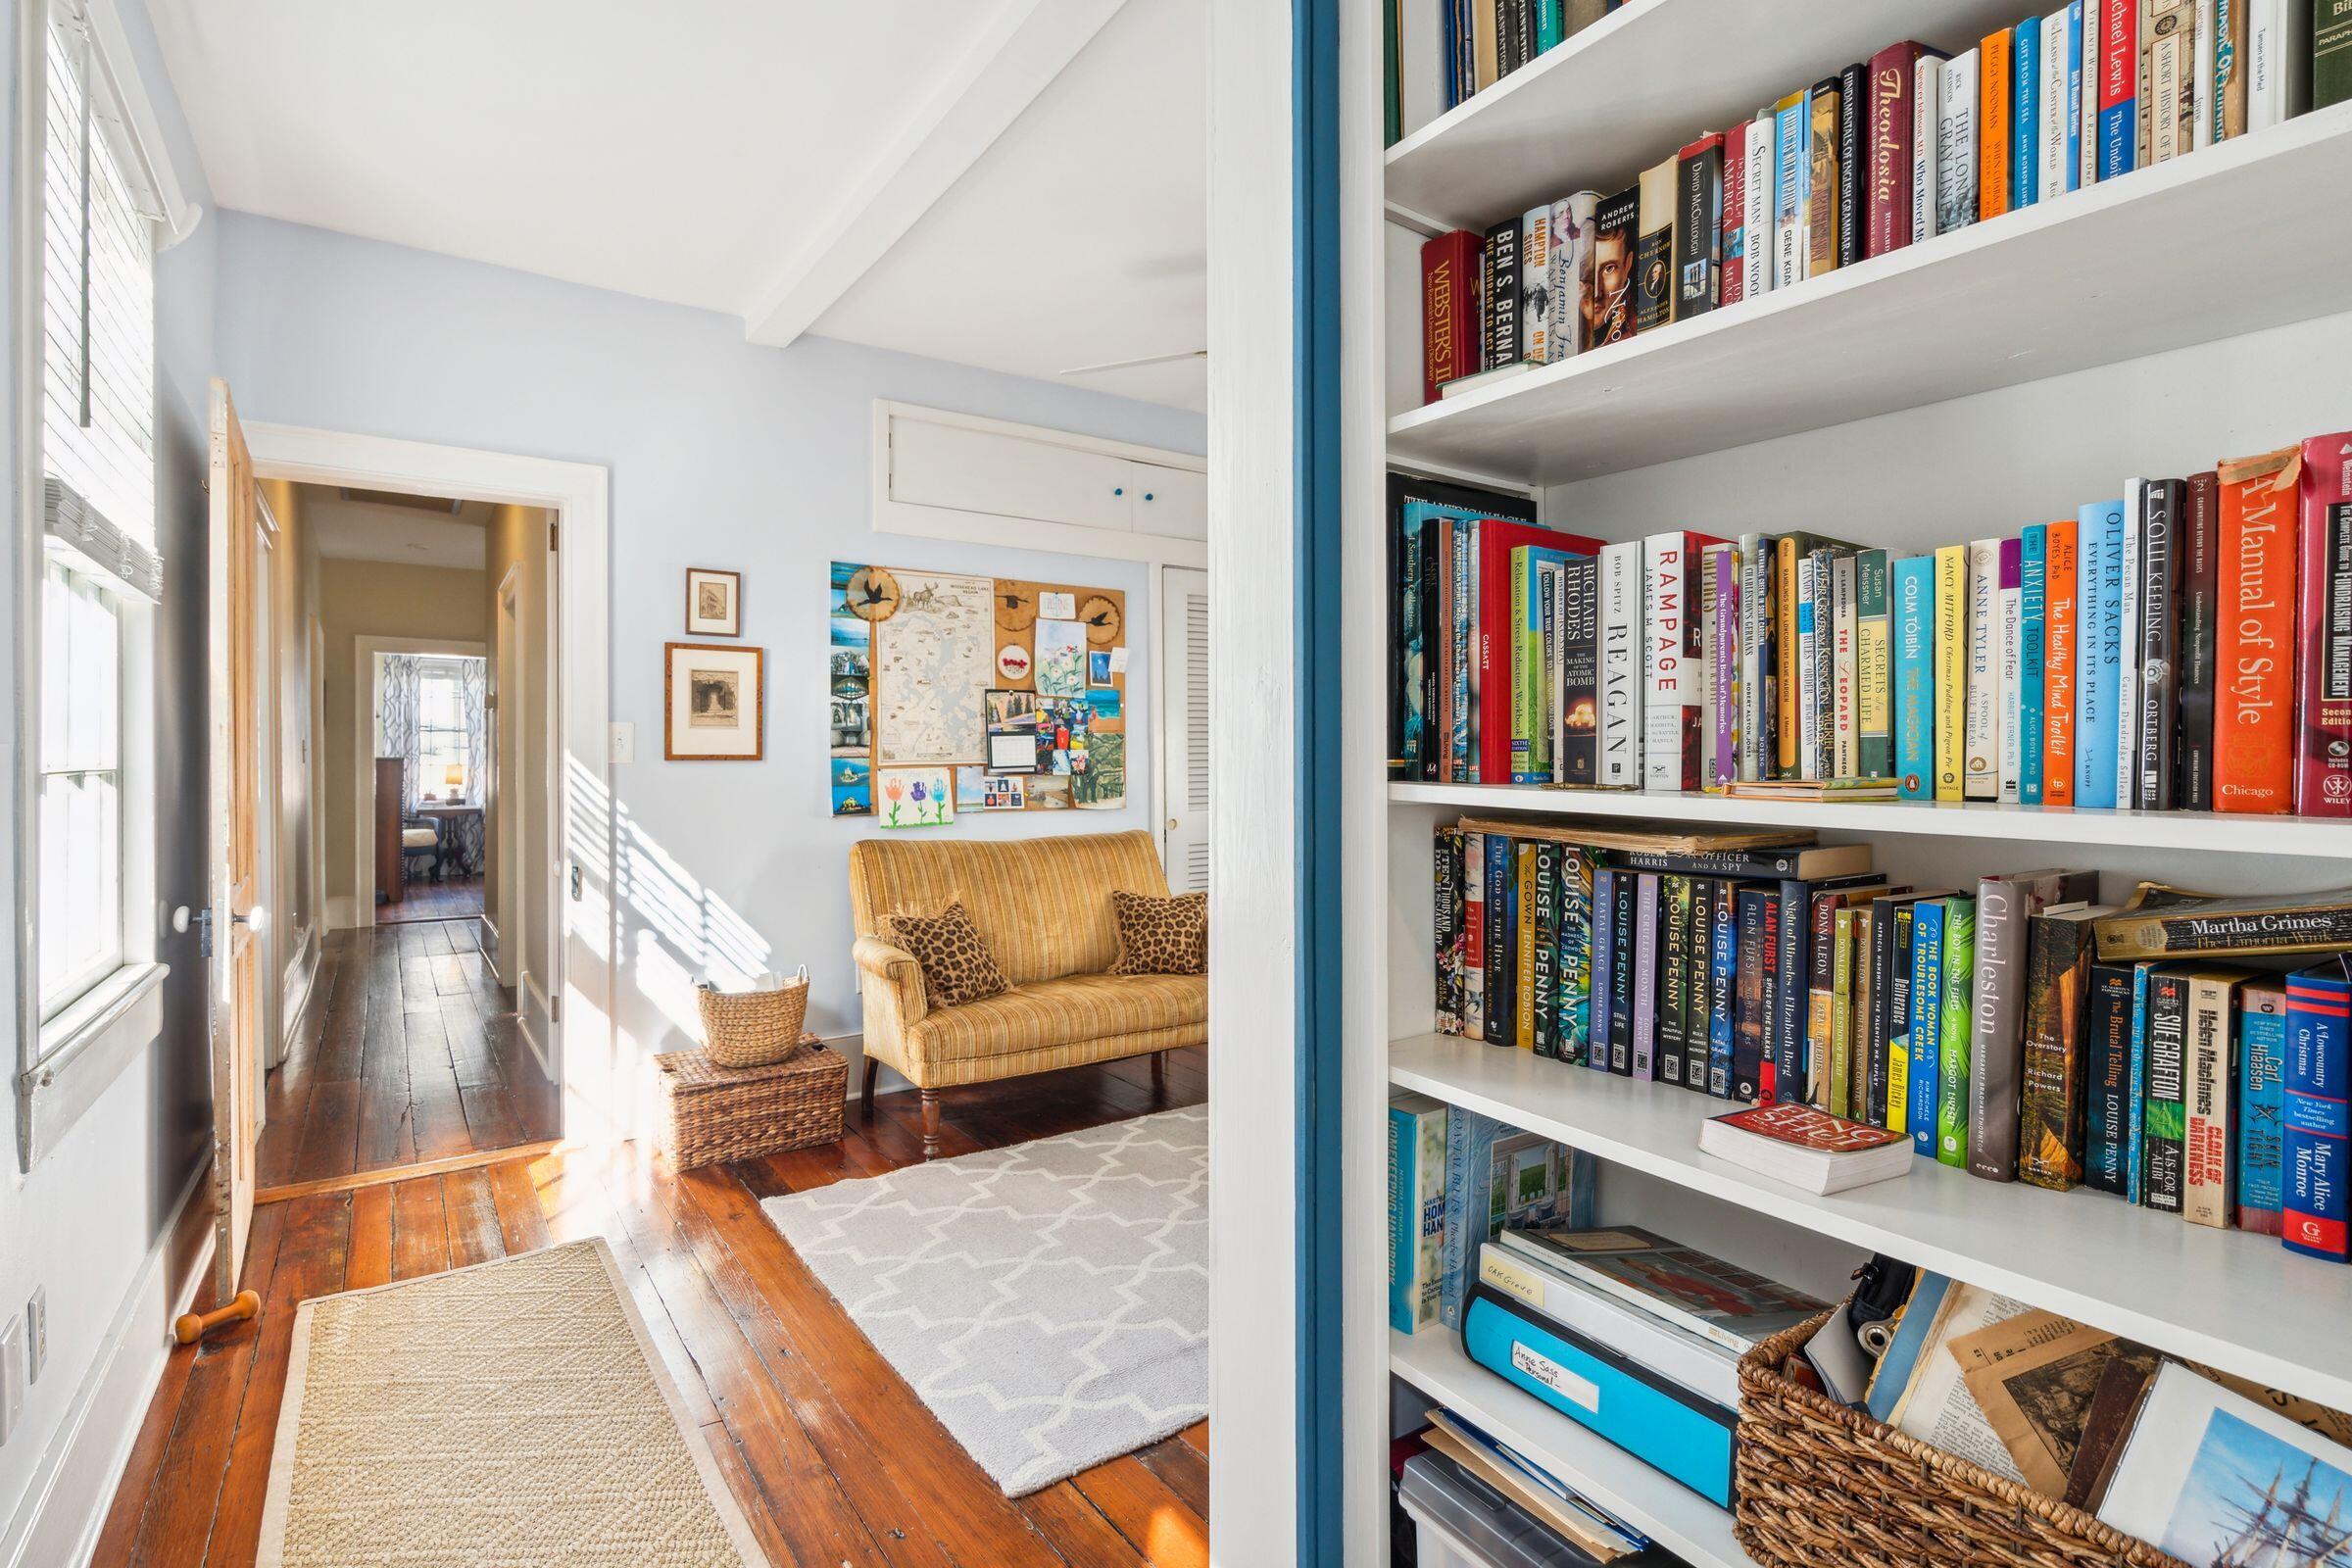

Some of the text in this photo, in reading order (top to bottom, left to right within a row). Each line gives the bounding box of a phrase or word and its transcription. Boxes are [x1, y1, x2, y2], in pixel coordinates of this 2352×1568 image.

[2020, 38, 2029, 60] GIFT
[2109, 45, 2128, 97] Lewis
[1989, 80, 1999, 130] NOONAN
[2070, 69, 2081, 138] Jack Russell Terriers
[2110, 110, 2124, 131] The
[2160, 88, 2172, 131] HISTORY
[1840, 71, 1854, 252] FUNDAMENTALS OF ENGLISH GRAMMAR
[1878, 68, 1901, 203] Theodosia
[1939, 117, 1954, 214] GRAY LINE
[1992, 139, 2002, 165] WHEN
[1691, 161, 1703, 192] DAVID
[1723, 159, 1735, 227] AMERICA
[1750, 145, 1766, 257] SECRET MAN BOB
[1600, 212, 1635, 231] ROBERTS
[1601, 202, 1636, 221] ANDREW
[1497, 229, 1514, 270] BEN
[1523, 233, 1533, 266] SIDES
[1533, 218, 1546, 268] HAMPTON
[1435, 260, 1452, 363] WEBSTER'S
[1485, 261, 1494, 311] COURAGE
[1558, 241, 1575, 324] Benjamin
[1638, 308, 1670, 324] HAMILTON
[1861, 563, 1872, 607] Meissner
[1873, 568, 1885, 599] Susan
[2063, 544, 2073, 571] ALICE
[1567, 565, 1583, 641] RHODES
[1582, 563, 1595, 640] RICHARD
[1904, 575, 1919, 614] COLM
[1944, 556, 1955, 641] NANCY MITFORD
[2023, 559, 2044, 679] ANXIETY TOOLKIT
[2103, 512, 2122, 666] OLIVER SACKS
[2230, 501, 2277, 725] Manual Style
[1645, 565, 1654, 680] JAMES SCOTT
[1658, 550, 1679, 692] RAMPAGE
[1838, 628, 1849, 655] THE
[1974, 574, 1988, 675] ANNE TYLER
[2004, 598, 2017, 680] The Dance Fear
[2084, 542, 2098, 725] EVERYTHING IN ITS PLACE
[1482, 634, 1491, 671] CASSATT
[1566, 676, 1595, 687] BOMB
[1860, 628, 1874, 724] CHARMED LIFE
[2046, 597, 2071, 757] The Healthy Mind Toolkit
[2331, 636, 2351, 697] MANAGEMENT
[1514, 691, 1525, 737] Workbook
[1606, 623, 1629, 755] REAGAN
[1968, 684, 1978, 748] BLUE THREAD
[2145, 699, 2159, 762] ORTBERG
[2222, 783, 2275, 798] Chicago
[1536, 843, 1551, 919] LOUISE
[1564, 846, 1581, 923] LOUISE
[1631, 857, 1668, 867] HARRIS
[1523, 879, 1533, 983] GOWN JENNIFER
[1616, 890, 1628, 1004] LOUISE PENNY
[1668, 894, 1681, 1011] LOUISE PENNY
[1744, 903, 1758, 977] ALAN FURST
[1764, 901, 1779, 973] ALAN FURST
[1816, 904, 1830, 976] DONNA LEON
[2190, 914, 2332, 936] Martha Grimes
[1535, 949, 1550, 1020] PENNY
[1693, 896, 1707, 1015] LOUISE PENNY
[1715, 901, 1729, 1022] LOUISE PENNY
[1978, 893, 2009, 1036] Charleston
[1558, 955, 1579, 1027] PENNY
[1613, 1012, 1627, 1021] STILL
[1892, 977, 1911, 1024] Deliverance
[1914, 922, 1928, 1061] OF TROUBLESOME CREEK
[1926, 940, 1938, 1047] THE BOOK WOMAN
[2025, 1040, 2068, 1054] Overstory
[2038, 1033, 2055, 1042] The
[2152, 1013, 2181, 1040] SUE
[2297, 1028, 2311, 1077] Christmas
[2027, 1066, 2063, 1081] Richard
[2028, 1080, 2062, 1093] Powers
[2151, 1041, 2180, 1101] GRAFTON
[2249, 1043, 2270, 1092] Hiaasen
[2264, 1055, 2283, 1084] Carl
[2293, 1110, 2336, 1126] bestselling
[2295, 1098, 2332, 1111] New York
[2300, 1121, 2327, 1130] author
[2303, 1106, 2326, 1115] Times
[2104, 1093, 2119, 1183] LOUISE PENNY
[1388, 1118, 1399, 1287] HOMEKEEPING HANDBOOK
[2295, 1146, 2312, 1199] Monroe
[2313, 1141, 2331, 1212] Mary Alice
[1446, 1220, 1460, 1299] Phoebe Howard
[1488, 1264, 1504, 1280] OAK
[1513, 1347, 1559, 1379] Anne Sass
[1717, 1329, 1740, 1348] Living
